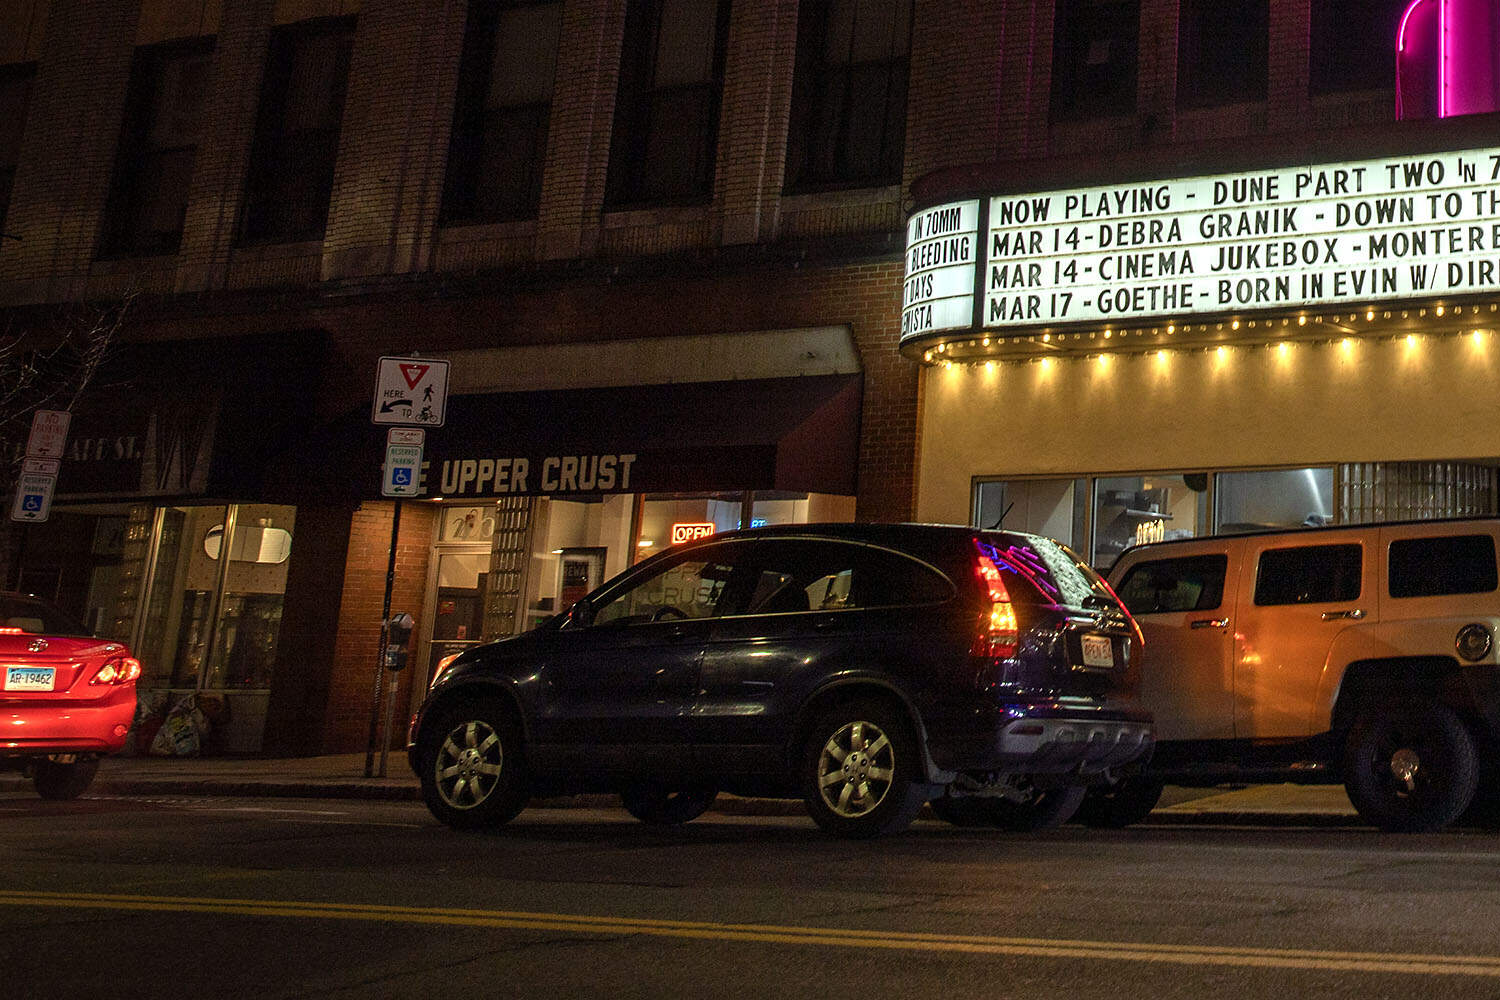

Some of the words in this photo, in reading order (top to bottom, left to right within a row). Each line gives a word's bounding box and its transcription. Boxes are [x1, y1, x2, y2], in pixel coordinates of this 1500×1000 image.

[1001, 198, 1051, 226] NOW
[1065, 186, 1171, 220] PLAYING
[1213, 175, 1279, 206] DUNE
[1295, 168, 1367, 200] PART
[1385, 160, 1445, 190] TWO
[914, 216, 924, 240] IN
[926, 207, 961, 236] 70MM
[993, 231, 1042, 258] MAR
[1199, 207, 1297, 240] GRANIK
[1336, 198, 1414, 228] DOWN
[1427, 193, 1463, 220] TO
[912, 236, 969, 272] BLEEDING
[991, 263, 1041, 289] MAR
[1210, 238, 1338, 272] JUKEBOX
[910, 274, 933, 303] DAYS
[990, 295, 1041, 322] MAR
[1218, 275, 1290, 305] BORN
[1302, 273, 1324, 300] IN
[1334, 267, 1397, 297] EVIN
[384, 390, 404, 398] HERE
[402, 408, 412, 417] TO
[440, 457, 529, 494] UPPER
[541, 453, 638, 492] CRUST
